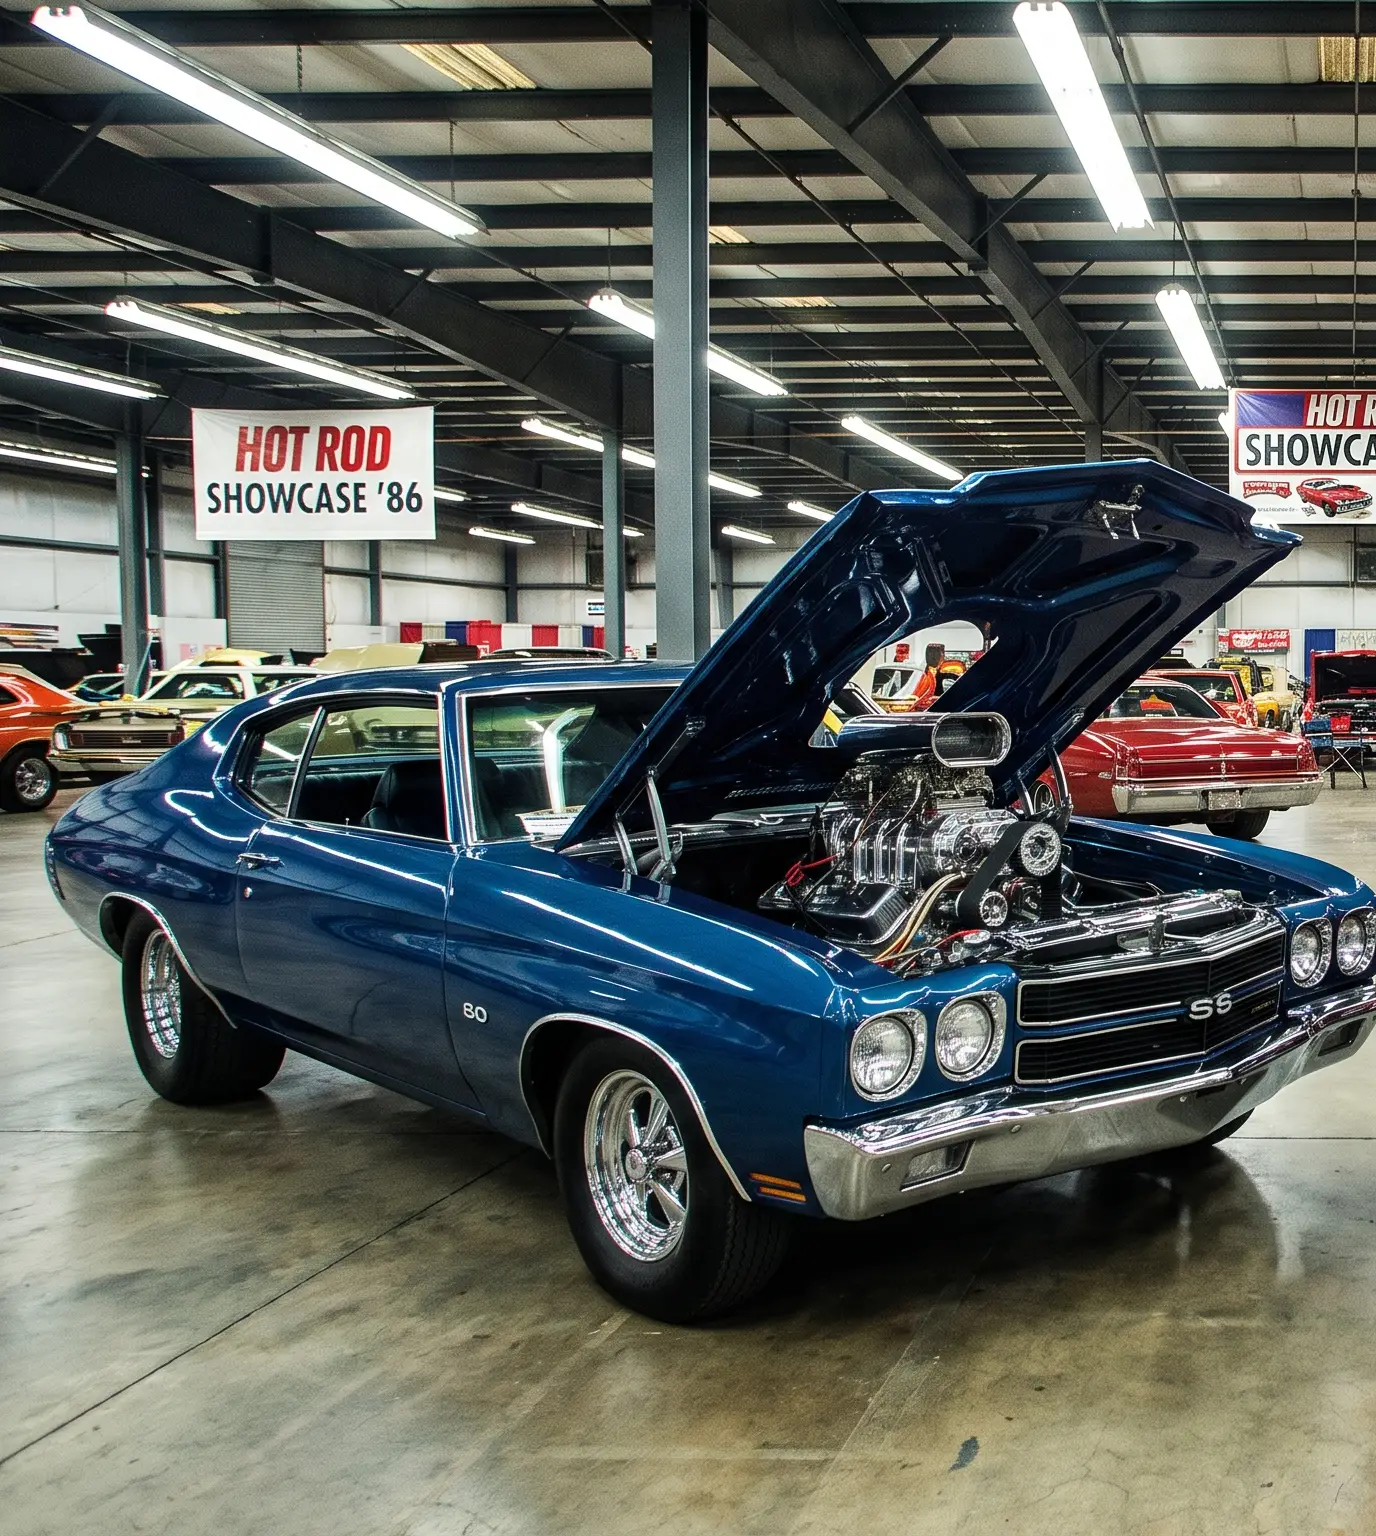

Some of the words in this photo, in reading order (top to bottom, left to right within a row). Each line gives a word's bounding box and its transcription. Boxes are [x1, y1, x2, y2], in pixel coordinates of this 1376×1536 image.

[1306, 394, 1361, 426] HOT
[235, 425, 310, 472] HOT
[315, 425, 392, 472] ROD
[207, 482, 367, 514] SHOWCASE
[377, 481, 423, 513] '86
[1188, 993, 1233, 1020] SS
